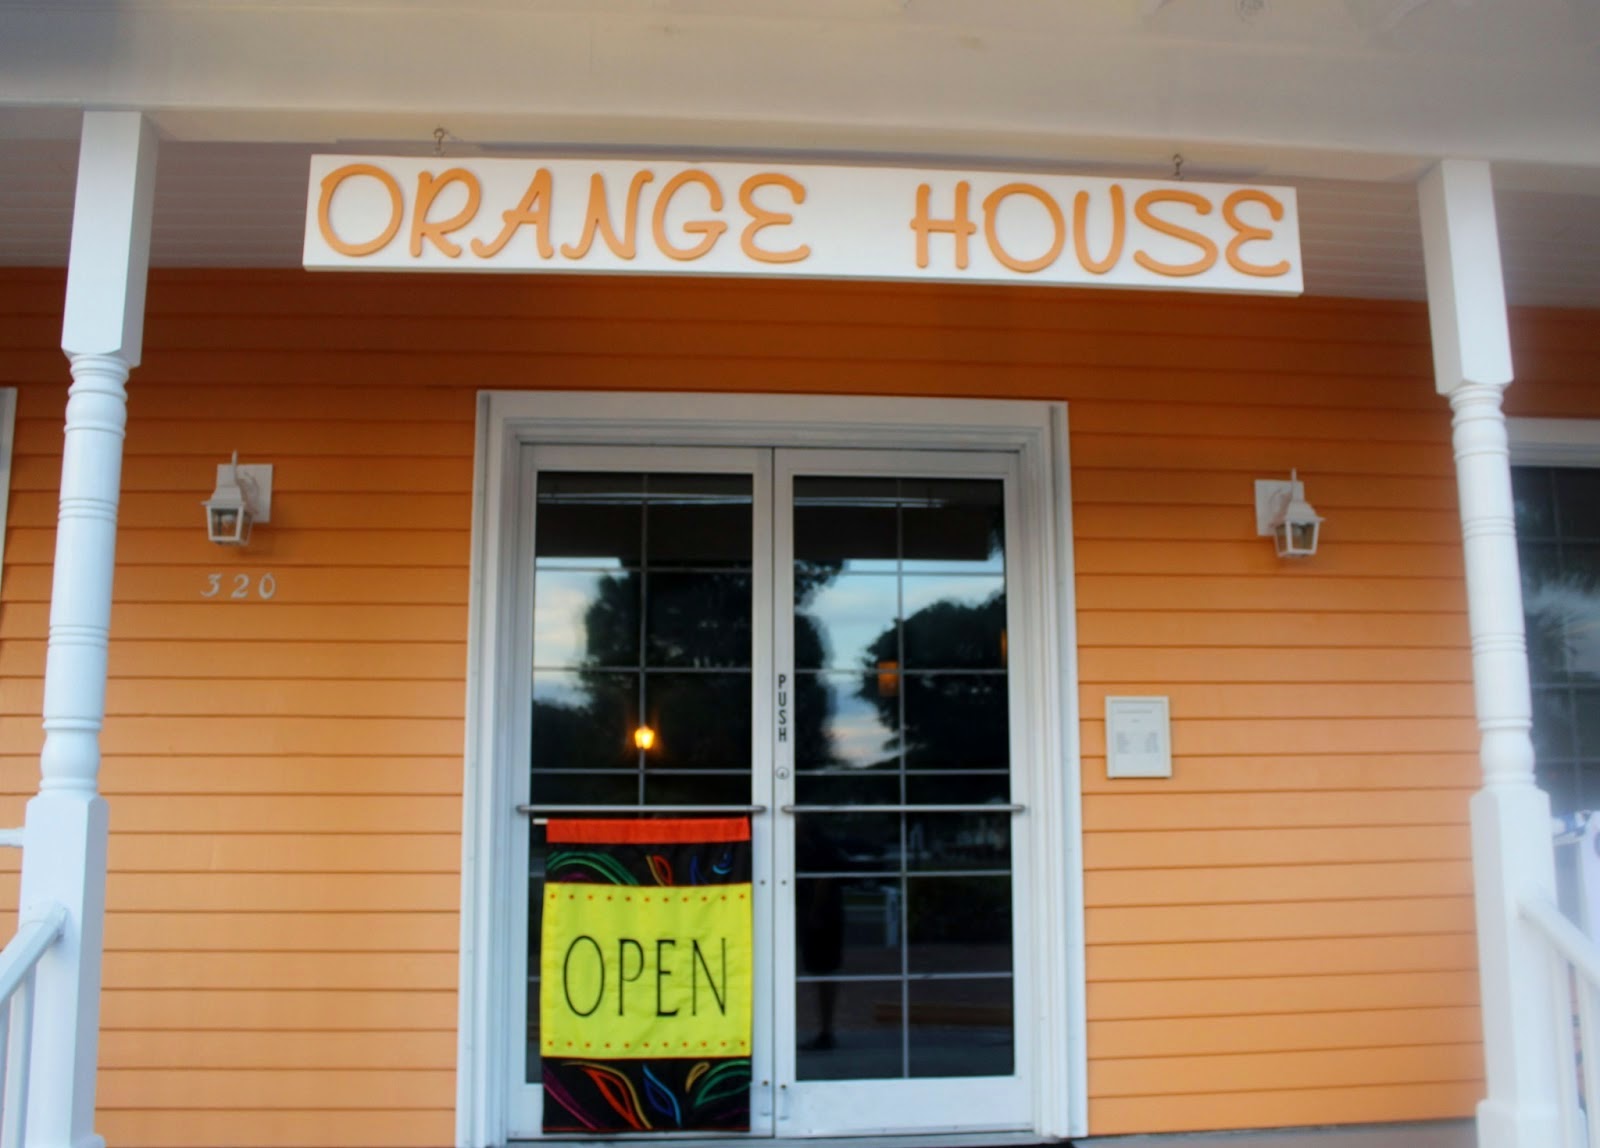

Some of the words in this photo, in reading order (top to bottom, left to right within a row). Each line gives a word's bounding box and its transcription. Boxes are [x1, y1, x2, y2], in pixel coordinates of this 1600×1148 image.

[318, 163, 811, 264] ORANGE
[910, 180, 1292, 278] HOUSE
[200, 572, 276, 600] 320
[778, 673, 787, 742] PUSH
[563, 935, 727, 1018] OPEN
